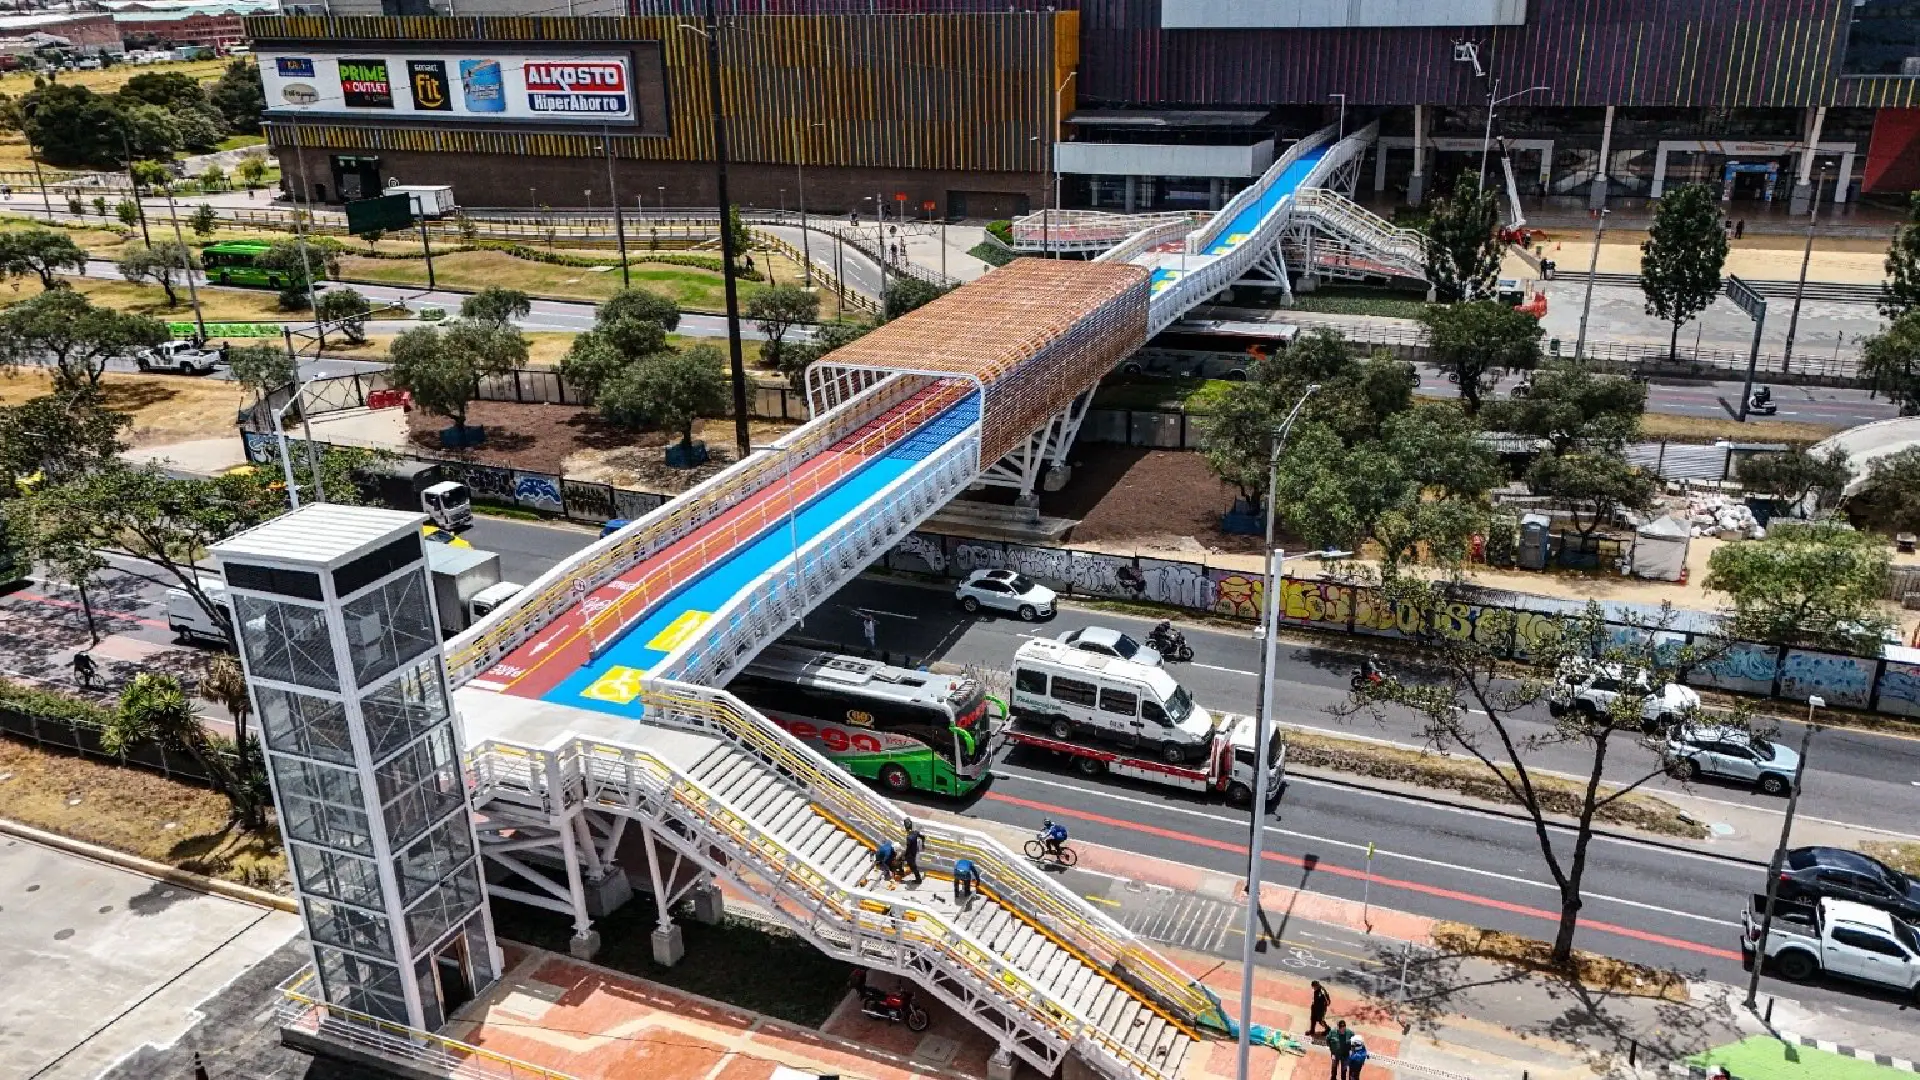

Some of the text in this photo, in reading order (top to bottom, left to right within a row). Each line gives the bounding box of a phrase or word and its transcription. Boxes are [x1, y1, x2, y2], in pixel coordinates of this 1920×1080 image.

[340, 64, 387, 82] PRIME
[528, 65, 619, 88] ALKOSTO
[352, 81, 388, 93] OUTLET
[534, 94, 619, 112] HiperAhorro
